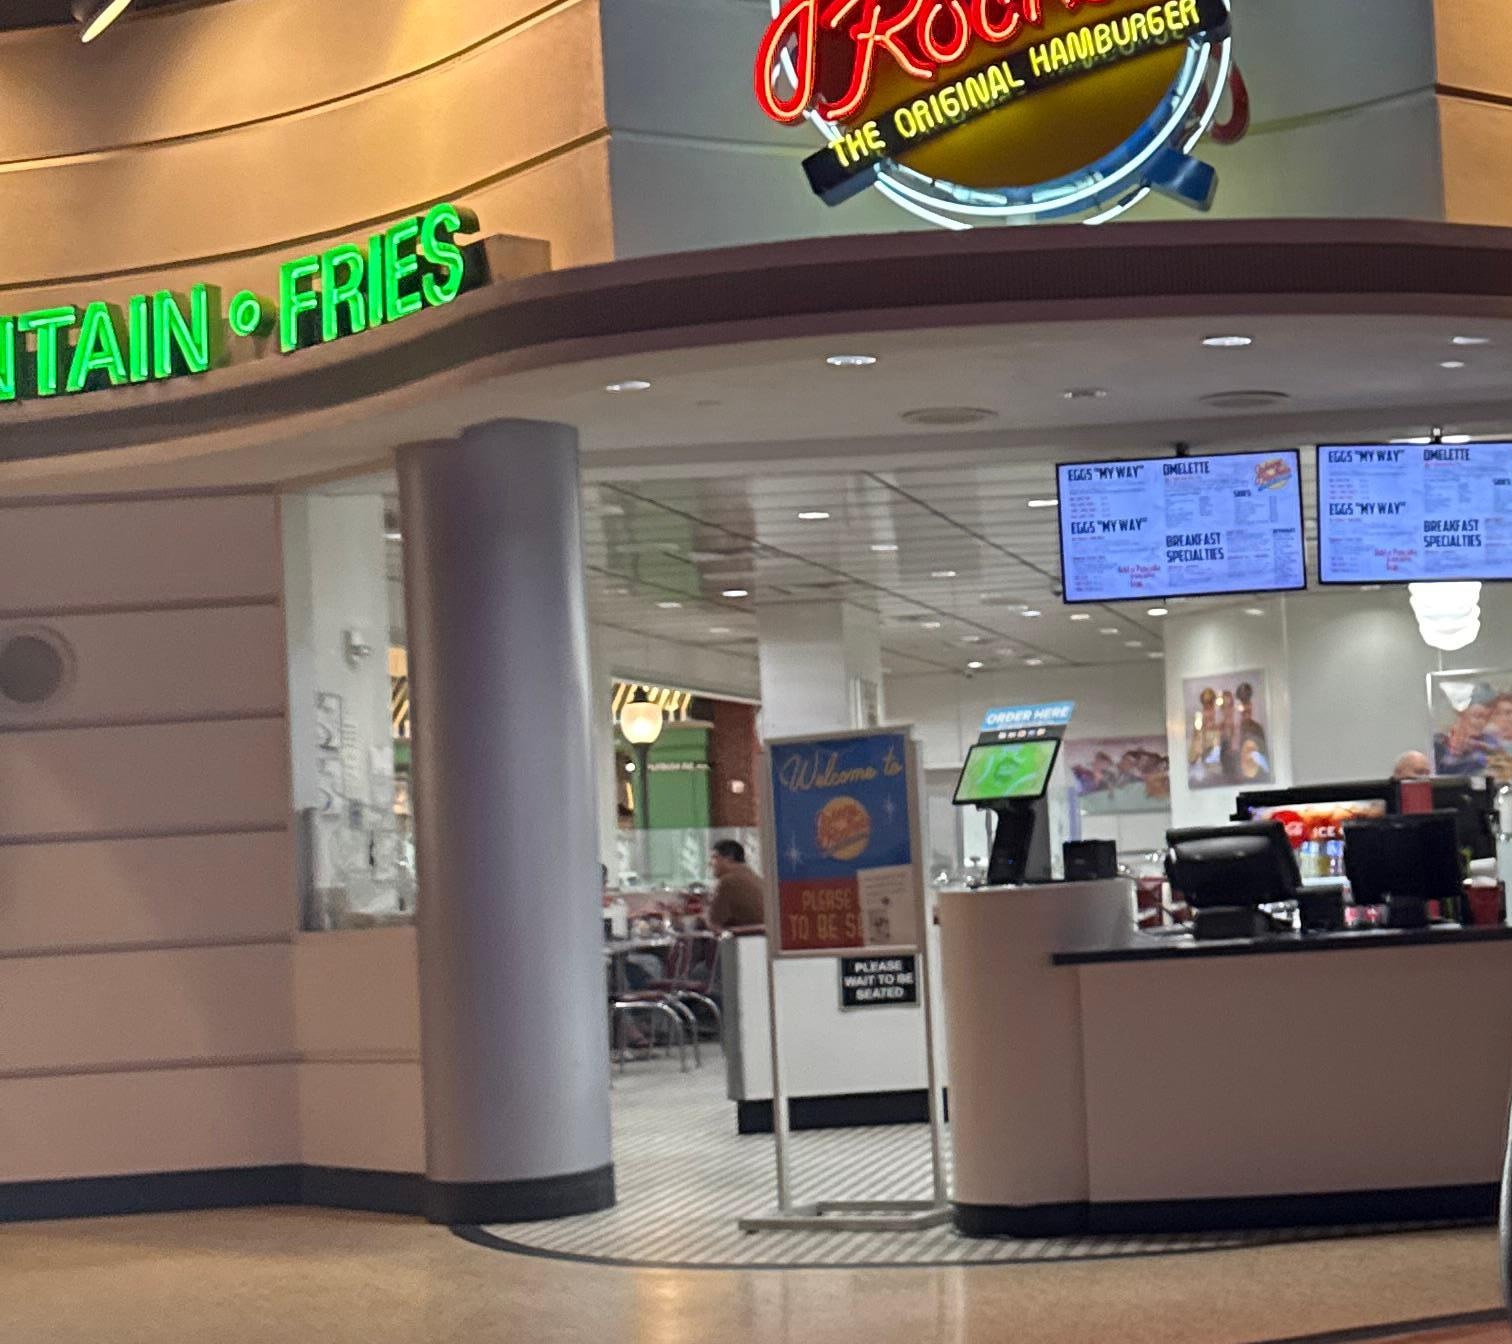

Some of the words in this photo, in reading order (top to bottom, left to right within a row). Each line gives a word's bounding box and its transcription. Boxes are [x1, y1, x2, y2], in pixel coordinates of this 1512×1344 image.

[828, 121, 886, 167] THE
[893, 60, 1024, 140] ORIGINAL
[0, 282, 208, 400] TAIN
[279, 202, 464, 353] FRIES
[1328, 451, 1354, 463] EGGS
[1423, 449, 1470, 461] OMELETTE
[1068, 467, 1094, 481] EGGS
[1163, 461, 1210, 476] OMELETTE
[1329, 503, 1354, 516] EGGS
[1071, 521, 1096, 534] EGGS
[1423, 520, 1479, 532] BREAKFAST
[1166, 532, 1221, 547] BREAKFAST
[1424, 534, 1482, 547] SPECIALTIES
[1166, 548, 1224, 563] SPECIALTIES
[987, 710, 1032, 725] ORDER
[1034, 706, 1070, 719] HERE
[780, 751, 877, 792] Welcome
[882, 750, 902, 776] to
[855, 960, 902, 973] PLEASE
[844, 975, 875, 987] WAIT
[878, 974, 895, 984] TO
[897, 972, 913, 984] BE
[855, 987, 904, 1000] SEATED
